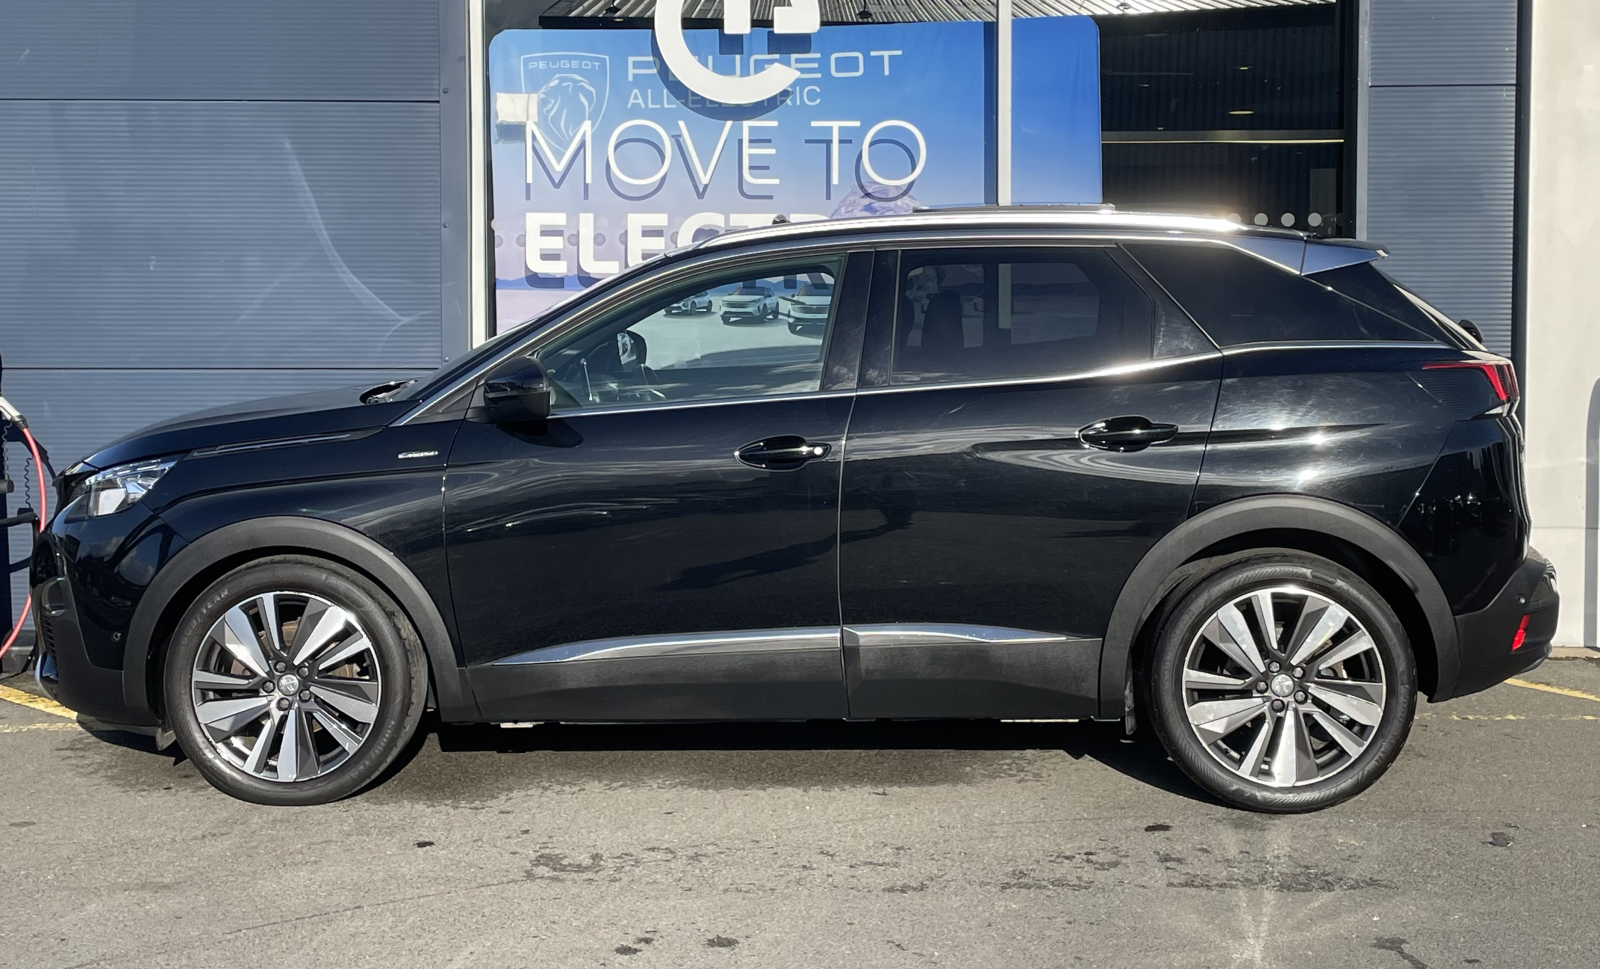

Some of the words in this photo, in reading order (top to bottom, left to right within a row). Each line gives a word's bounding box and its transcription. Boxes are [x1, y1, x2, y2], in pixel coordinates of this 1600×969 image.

[528, 60, 602, 70] PEUGEOT
[628, 50, 903, 82] PUGEOT
[525, 119, 780, 185] MOVE
[810, 119, 927, 186] TO
